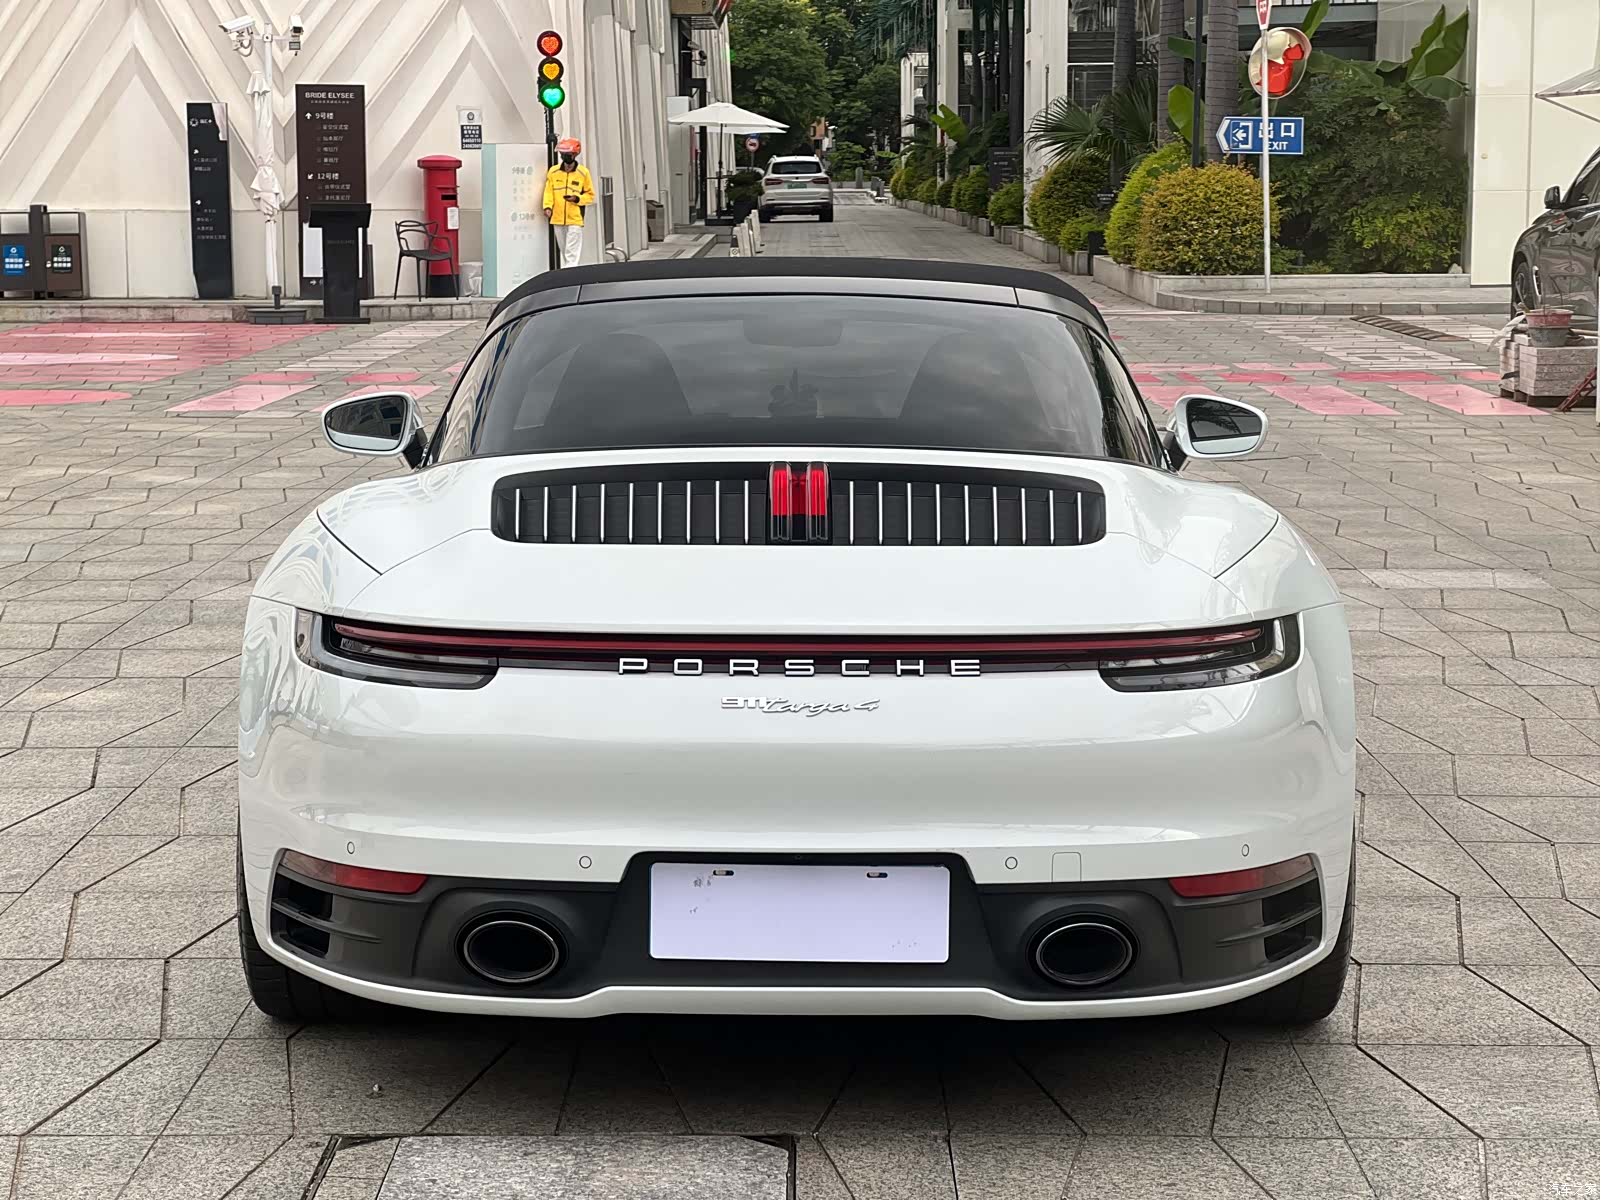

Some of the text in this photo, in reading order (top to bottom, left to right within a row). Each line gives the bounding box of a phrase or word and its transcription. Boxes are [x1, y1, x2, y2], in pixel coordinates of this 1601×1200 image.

[1258, 122, 1295, 139] 出口
[1267, 141, 1288, 150] EXIT
[618, 658, 982, 677] PORSCHE
[721, 696, 880, 717] 911 targa 4
